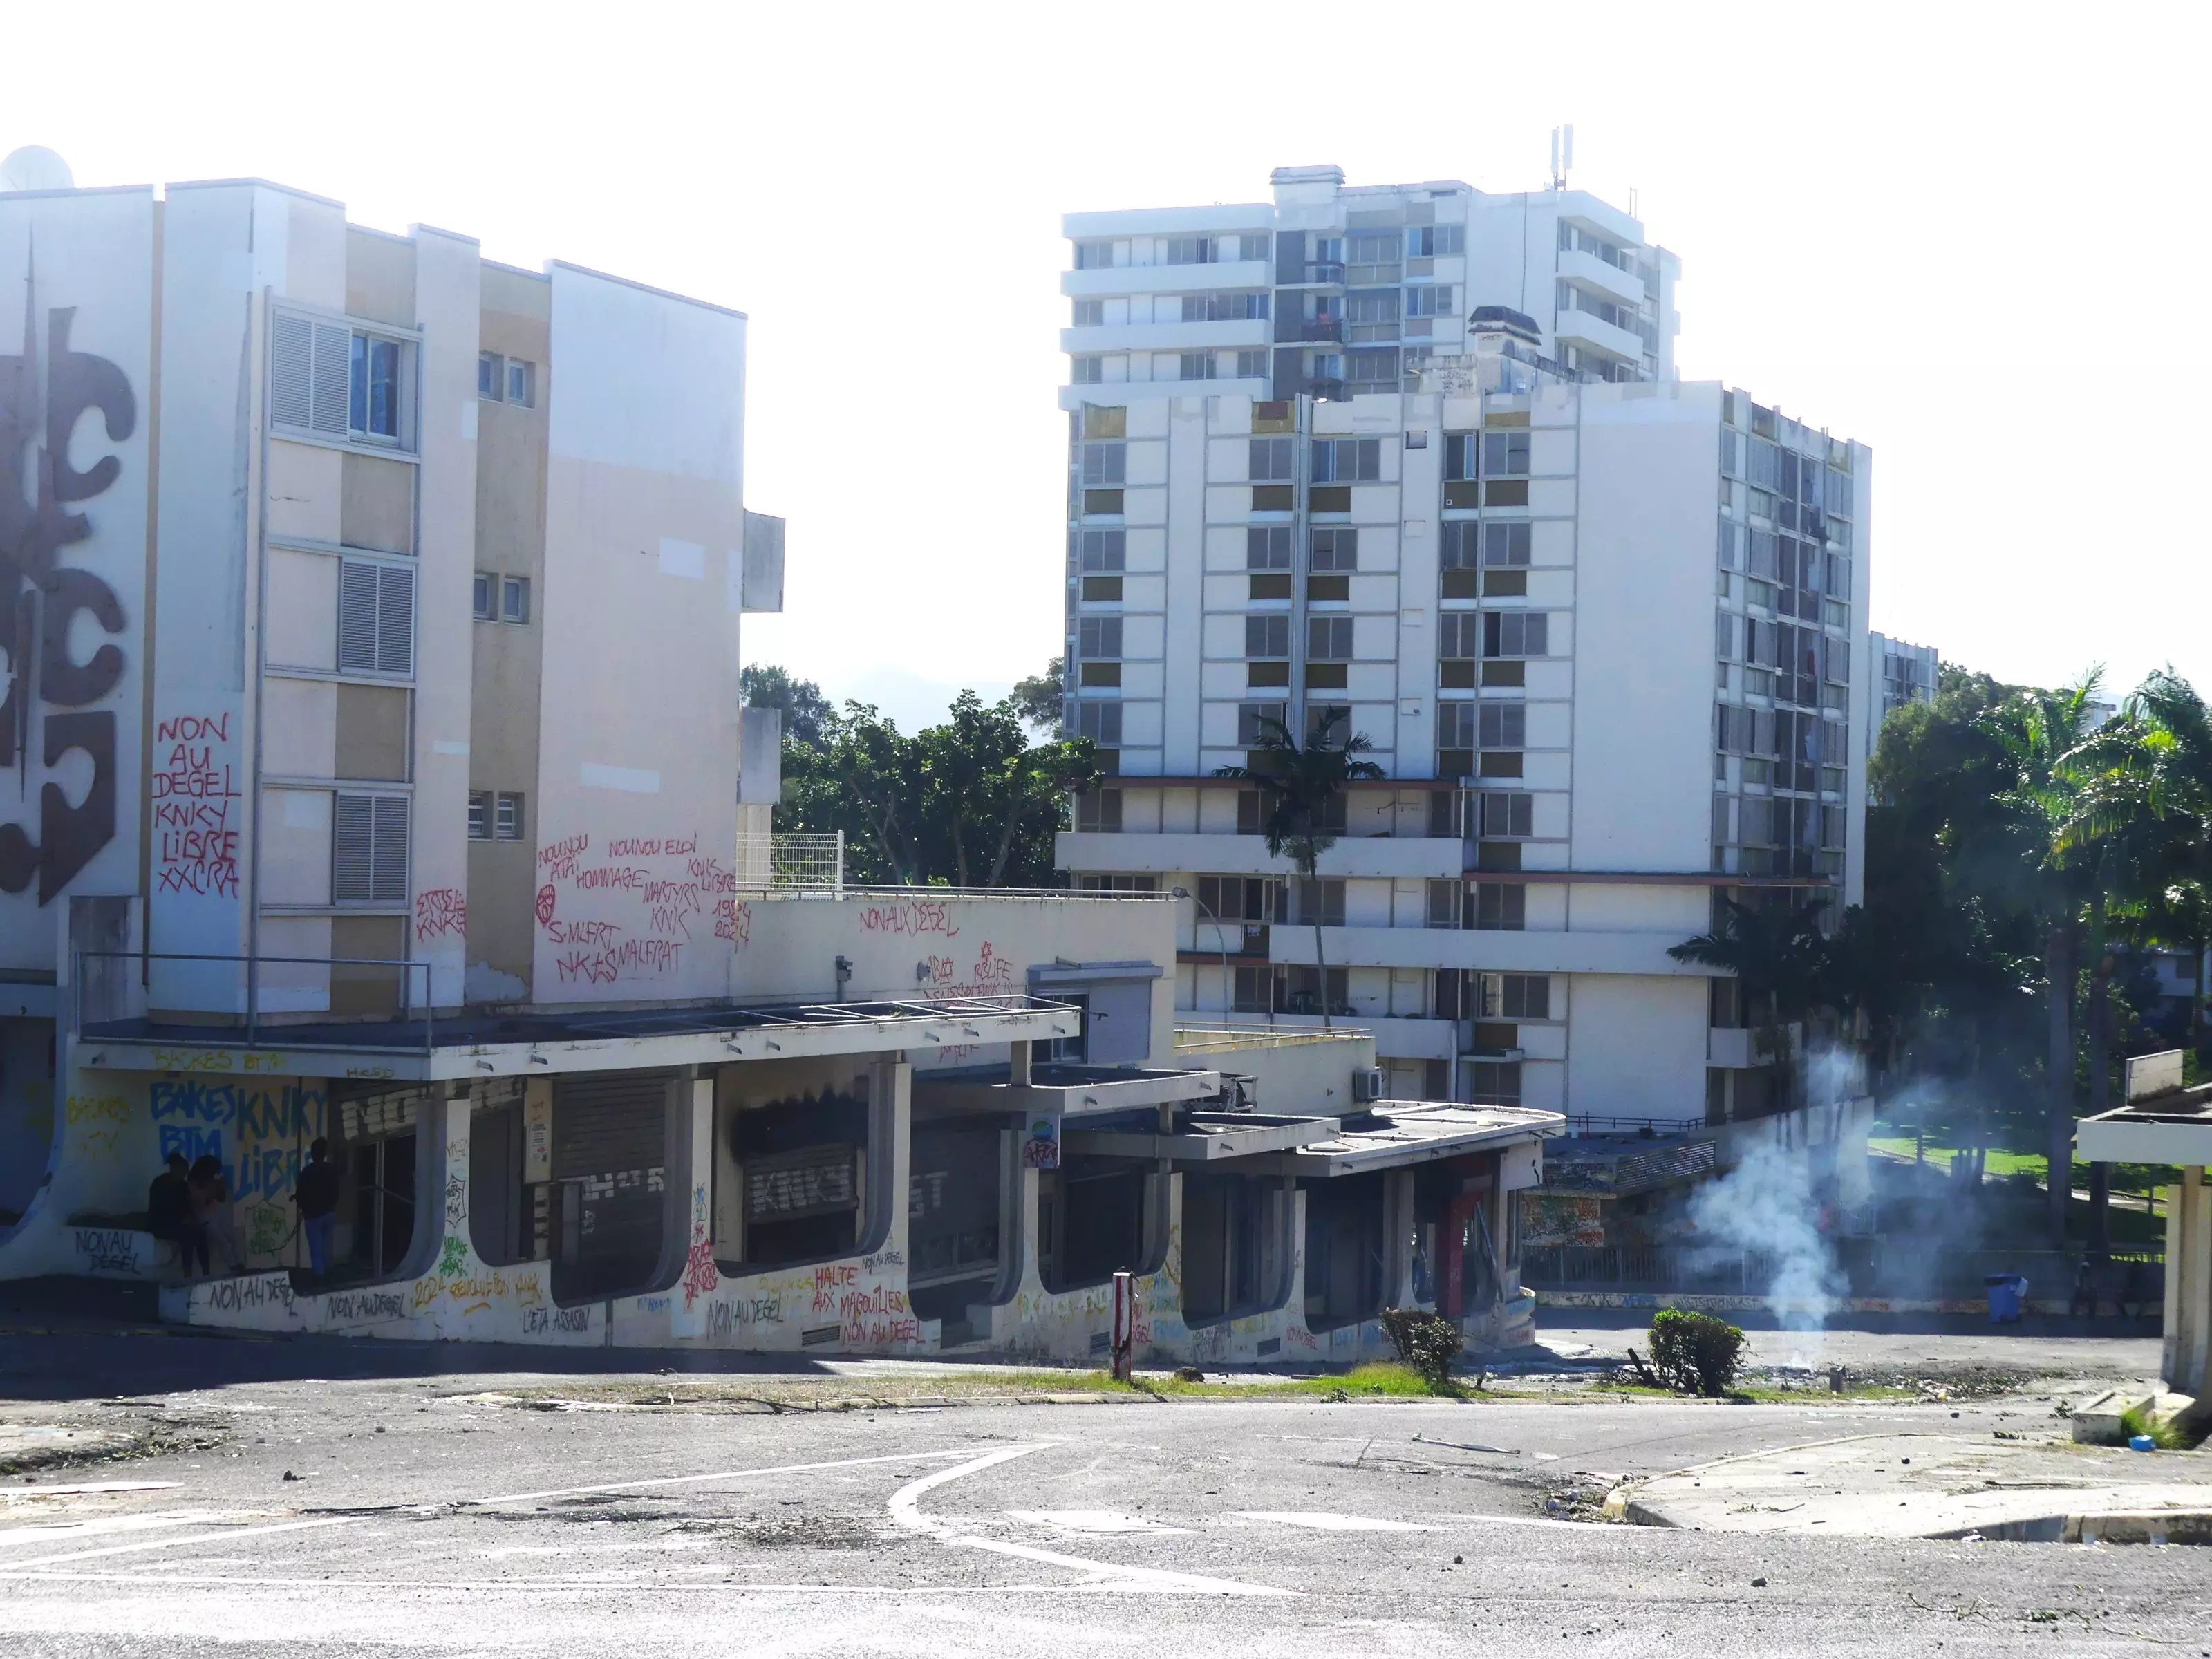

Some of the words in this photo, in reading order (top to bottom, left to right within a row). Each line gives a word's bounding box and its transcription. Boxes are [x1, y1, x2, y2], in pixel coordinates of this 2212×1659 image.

[158, 712, 229, 741] NON
[169, 744, 210, 773] AU
[151, 765, 241, 799] DEGEL
[609, 838, 660, 858] NOUNOU
[577, 867, 649, 892] HOMMAGE
[859, 907, 887, 933] NON
[236, 1085, 328, 1141] KNKY
[75, 1231, 108, 1255] NON
[110, 1231, 133, 1253] AU
[815, 1266, 858, 1290] HALTE
[210, 1283, 242, 1313] NON
[245, 1282, 265, 1306] AU
[327, 1295, 355, 1321] NON
[812, 1291, 835, 1312] AUX
[707, 1300, 734, 1340] NON
[843, 1321, 866, 1344] NON
[871, 1321, 886, 1344] AU
